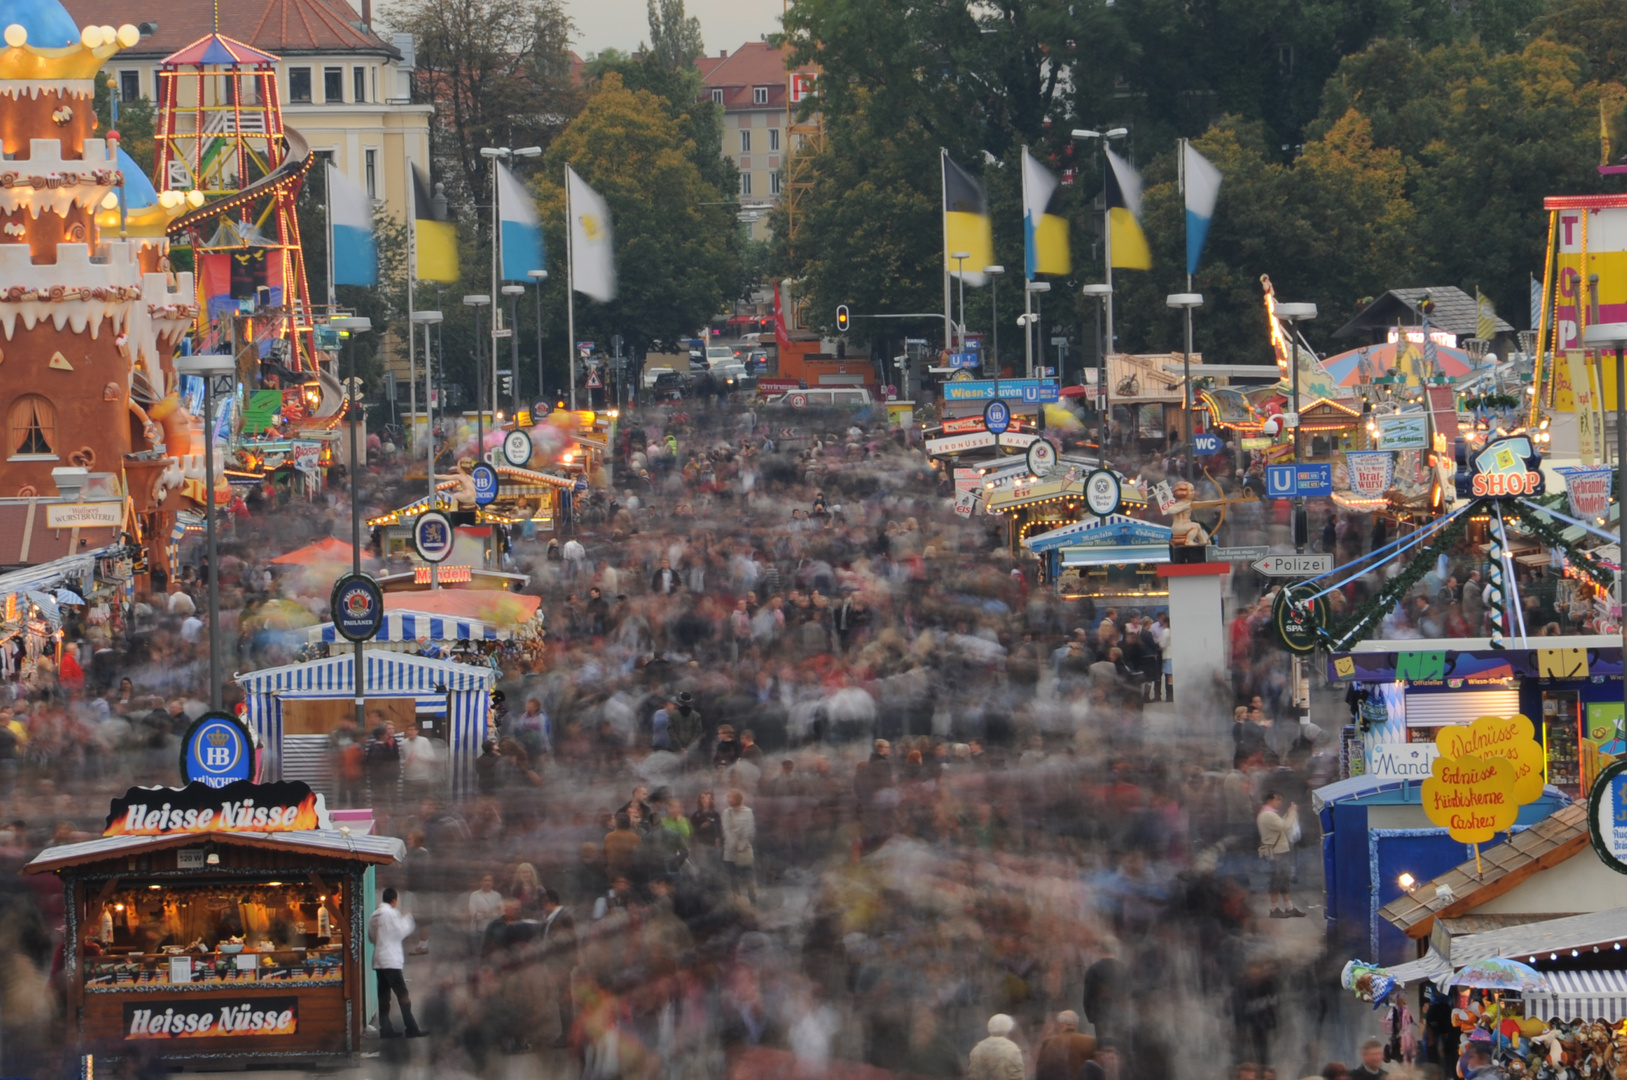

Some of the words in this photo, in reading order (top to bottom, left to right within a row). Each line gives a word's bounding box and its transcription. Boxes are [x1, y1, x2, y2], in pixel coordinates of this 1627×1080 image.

[965, 340, 977, 348] WC
[952, 356, 960, 365] U
[1026, 388, 1037, 400] U
[992, 411, 1001, 420] HB
[938, 438, 990, 451] ERDNÜSSE
[1195, 437, 1217, 450] WC
[476, 478, 488, 488] HB
[1273, 470, 1291, 491] U
[1358, 472, 1384, 481] Brat-
[1357, 480, 1383, 489] wurst
[1472, 471, 1540, 496] SHOP
[1572, 480, 1606, 493] Gebrannte
[1014, 488, 1032, 498] Eis
[957, 505, 971, 514] EIS
[1574, 495, 1605, 513] Mandeln
[1275, 558, 1325, 571] Polizei
[1450, 723, 1519, 759] Walnüsse
[206, 747, 230, 766] HB
[1442, 765, 1497, 785] Erdnüsse
[124, 802, 214, 831] Heisse
[218, 798, 298, 828] Nüsse
[1450, 811, 1496, 830] Cashew
[130, 1007, 214, 1035] Heisse
[218, 1003, 293, 1032] Nüsse
